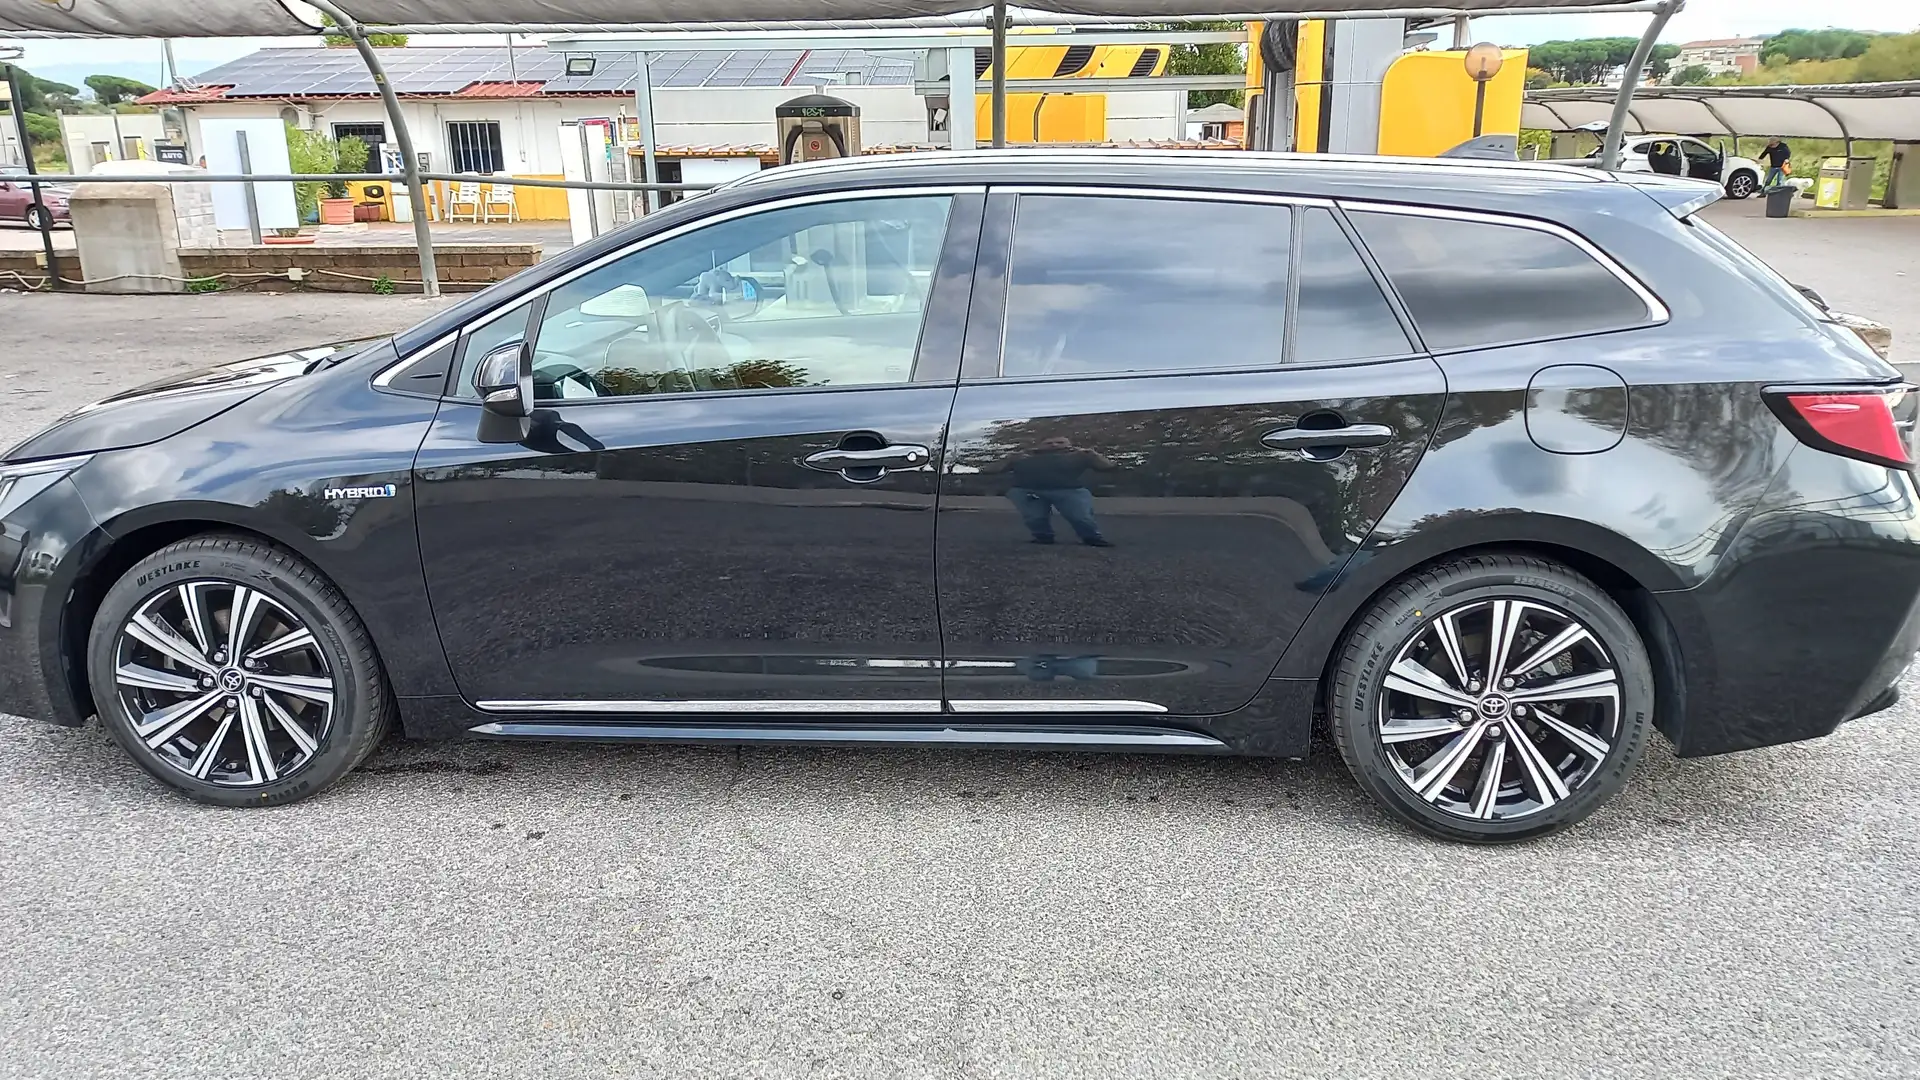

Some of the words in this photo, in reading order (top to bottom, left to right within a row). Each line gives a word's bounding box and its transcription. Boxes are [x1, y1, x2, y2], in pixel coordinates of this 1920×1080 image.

[324, 486, 386, 500] HYBRID
[136, 560, 200, 587] WESTLAKE
[1354, 641, 1385, 712] WESTLAKE
